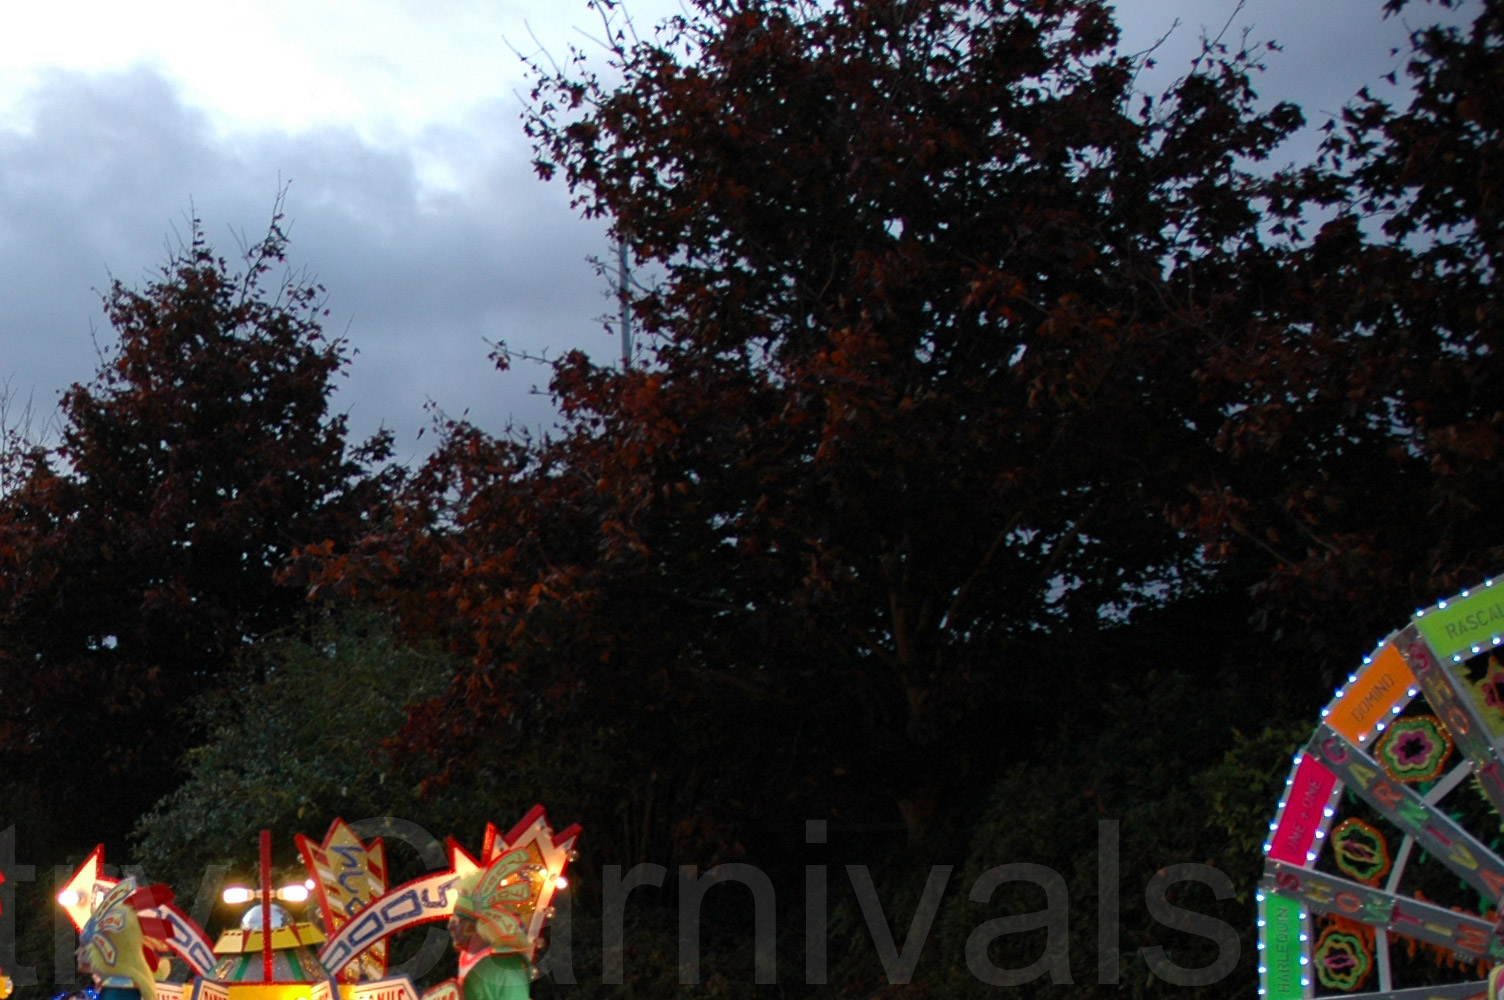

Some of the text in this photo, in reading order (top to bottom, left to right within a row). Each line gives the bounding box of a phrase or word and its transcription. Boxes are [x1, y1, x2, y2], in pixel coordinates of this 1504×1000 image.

[1351, 672, 1395, 724] DOMINO
[1285, 822, 1304, 854] ONE
[1307, 777, 1322, 809] ONE
[1276, 906, 1291, 994] HARLEQUIN
